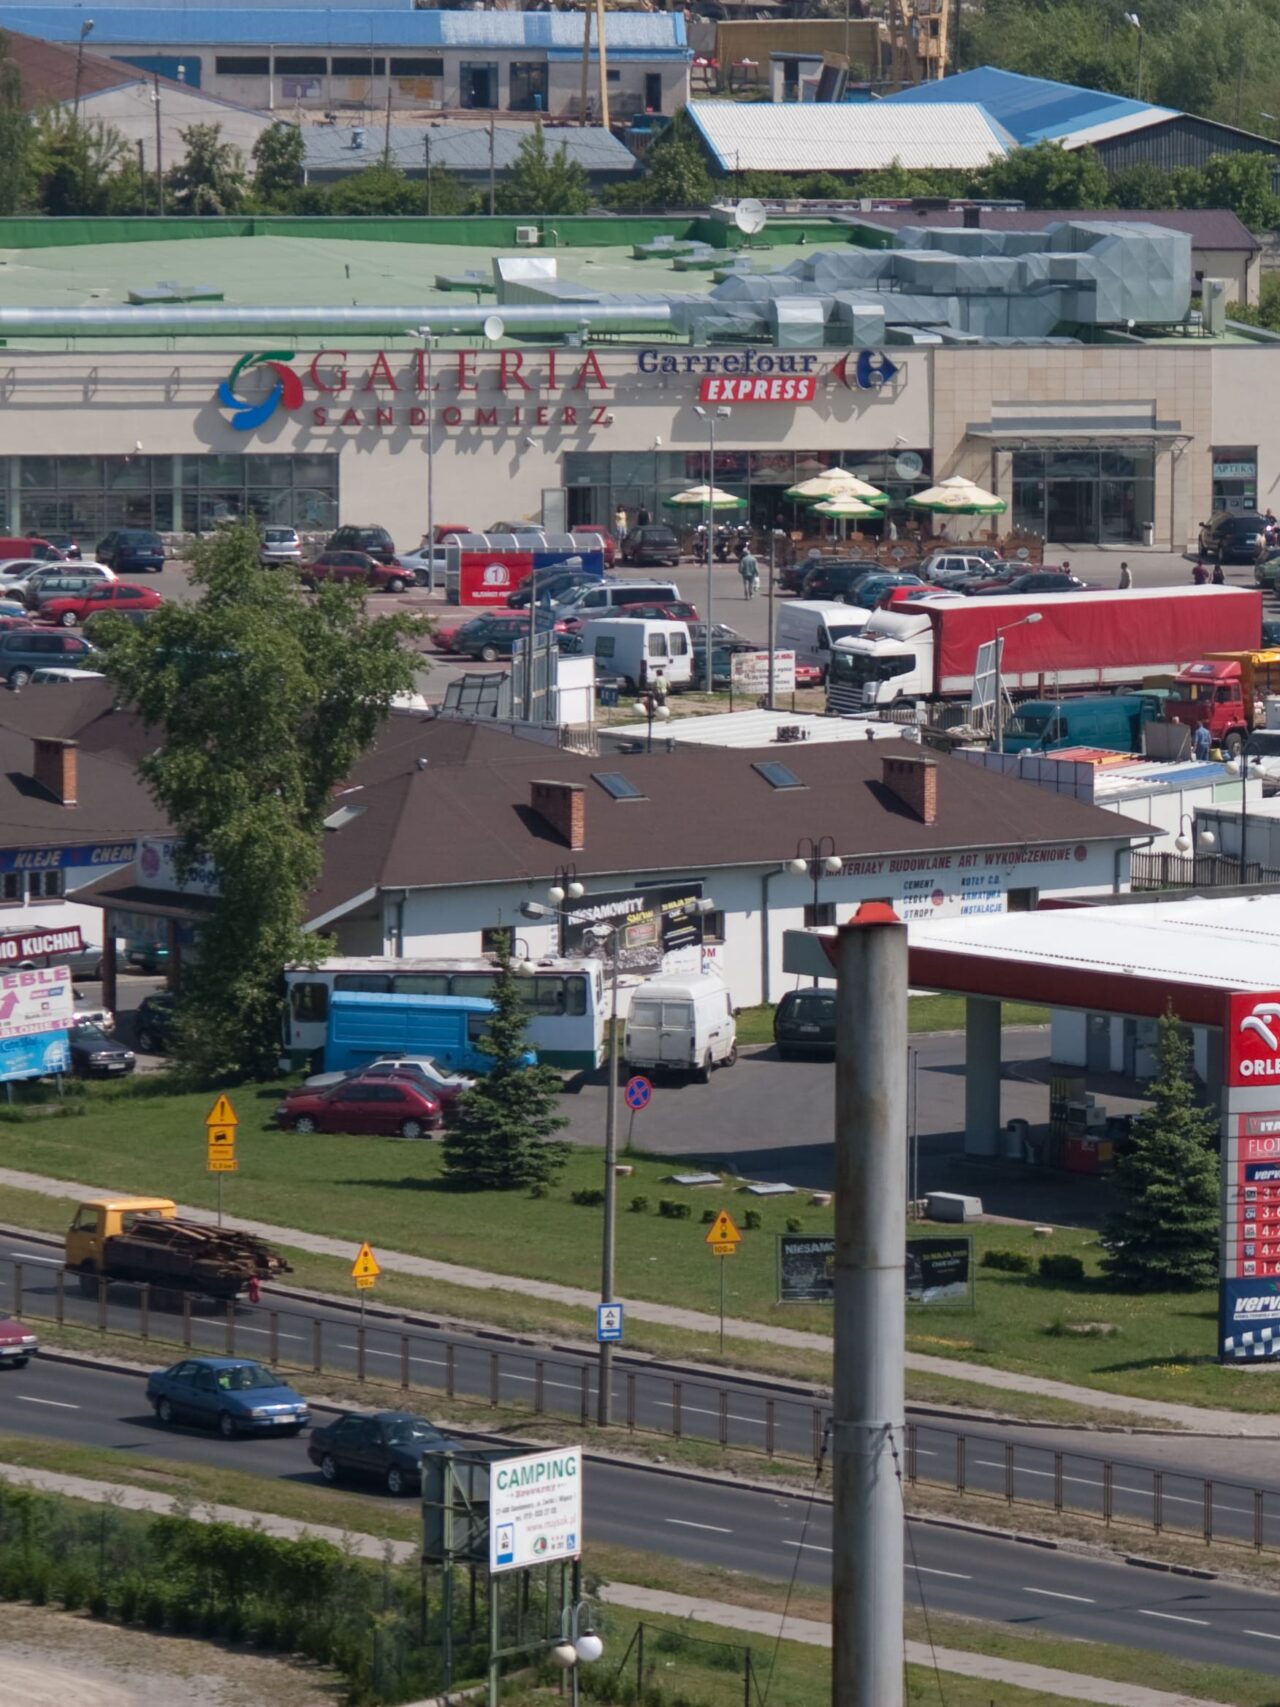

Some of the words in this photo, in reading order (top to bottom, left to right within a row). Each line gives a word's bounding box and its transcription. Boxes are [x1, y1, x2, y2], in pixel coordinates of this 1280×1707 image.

[310, 349, 609, 392] GALERIA
[637, 349, 818, 374] Carrefour
[707, 378, 809, 400] EXPRESS
[312, 405, 609, 427] SANDOMIERZ
[14, 851, 63, 868] KLEJE
[91, 845, 136, 863] CHEM
[889, 855, 952, 873] BUDOWLANE
[958, 853, 979, 868] ART
[903, 879, 935, 890] CEMENT
[903, 908, 934, 919] STROPY
[960, 903, 1003, 915] INSTALACJE
[22, 930, 80, 956] KUCHNI
[496, 1456, 577, 1491] CAMPING
